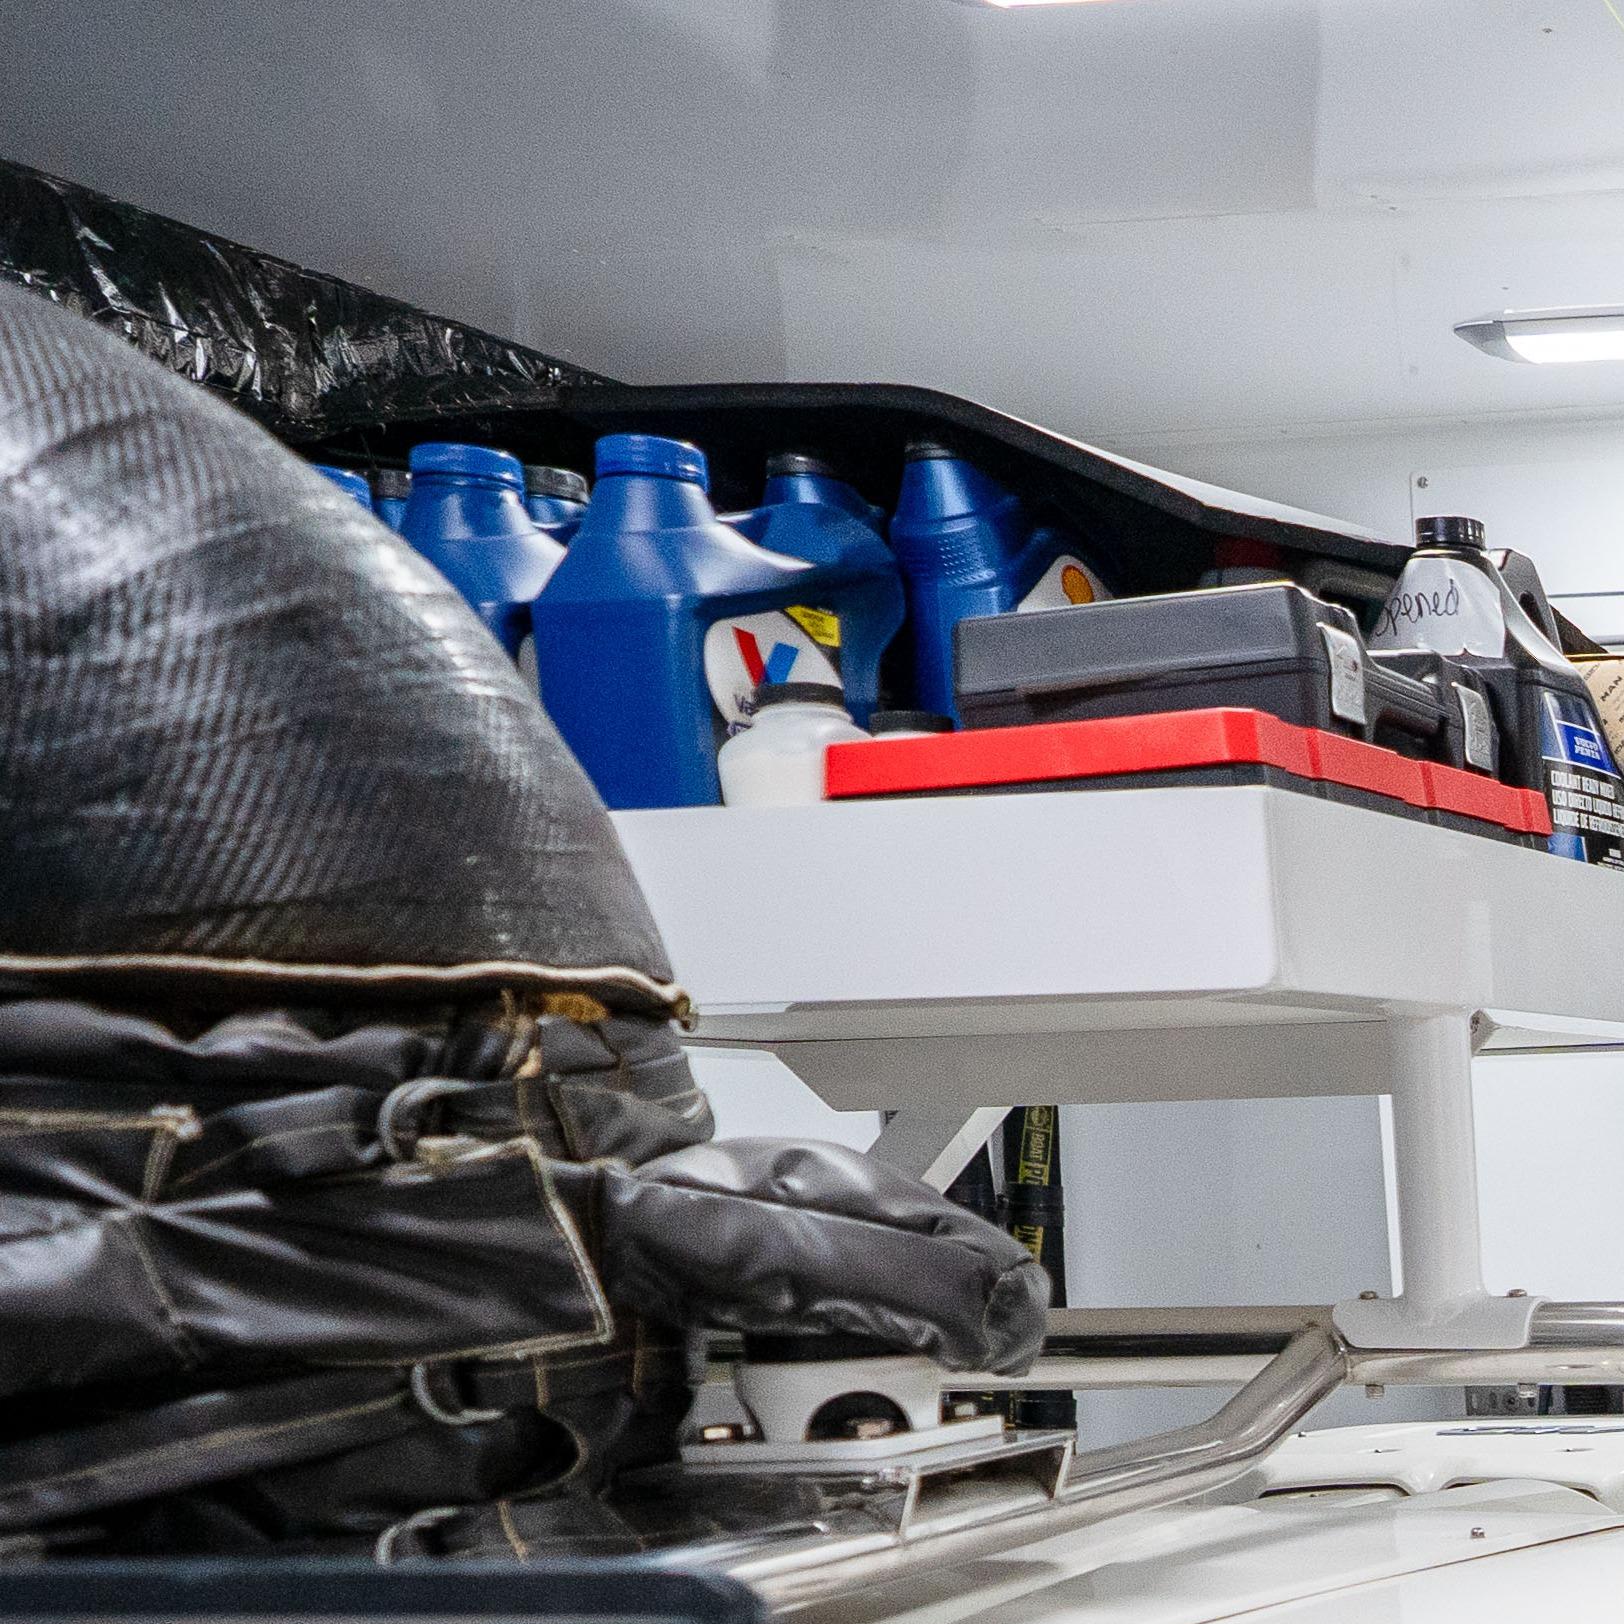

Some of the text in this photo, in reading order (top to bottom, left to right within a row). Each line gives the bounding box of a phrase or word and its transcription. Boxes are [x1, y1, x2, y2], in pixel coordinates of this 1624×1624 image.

[1600, 675, 1623, 702] MAN
[1574, 735, 1600, 753] VOLVO
[1574, 744, 1601, 761] PENTA
